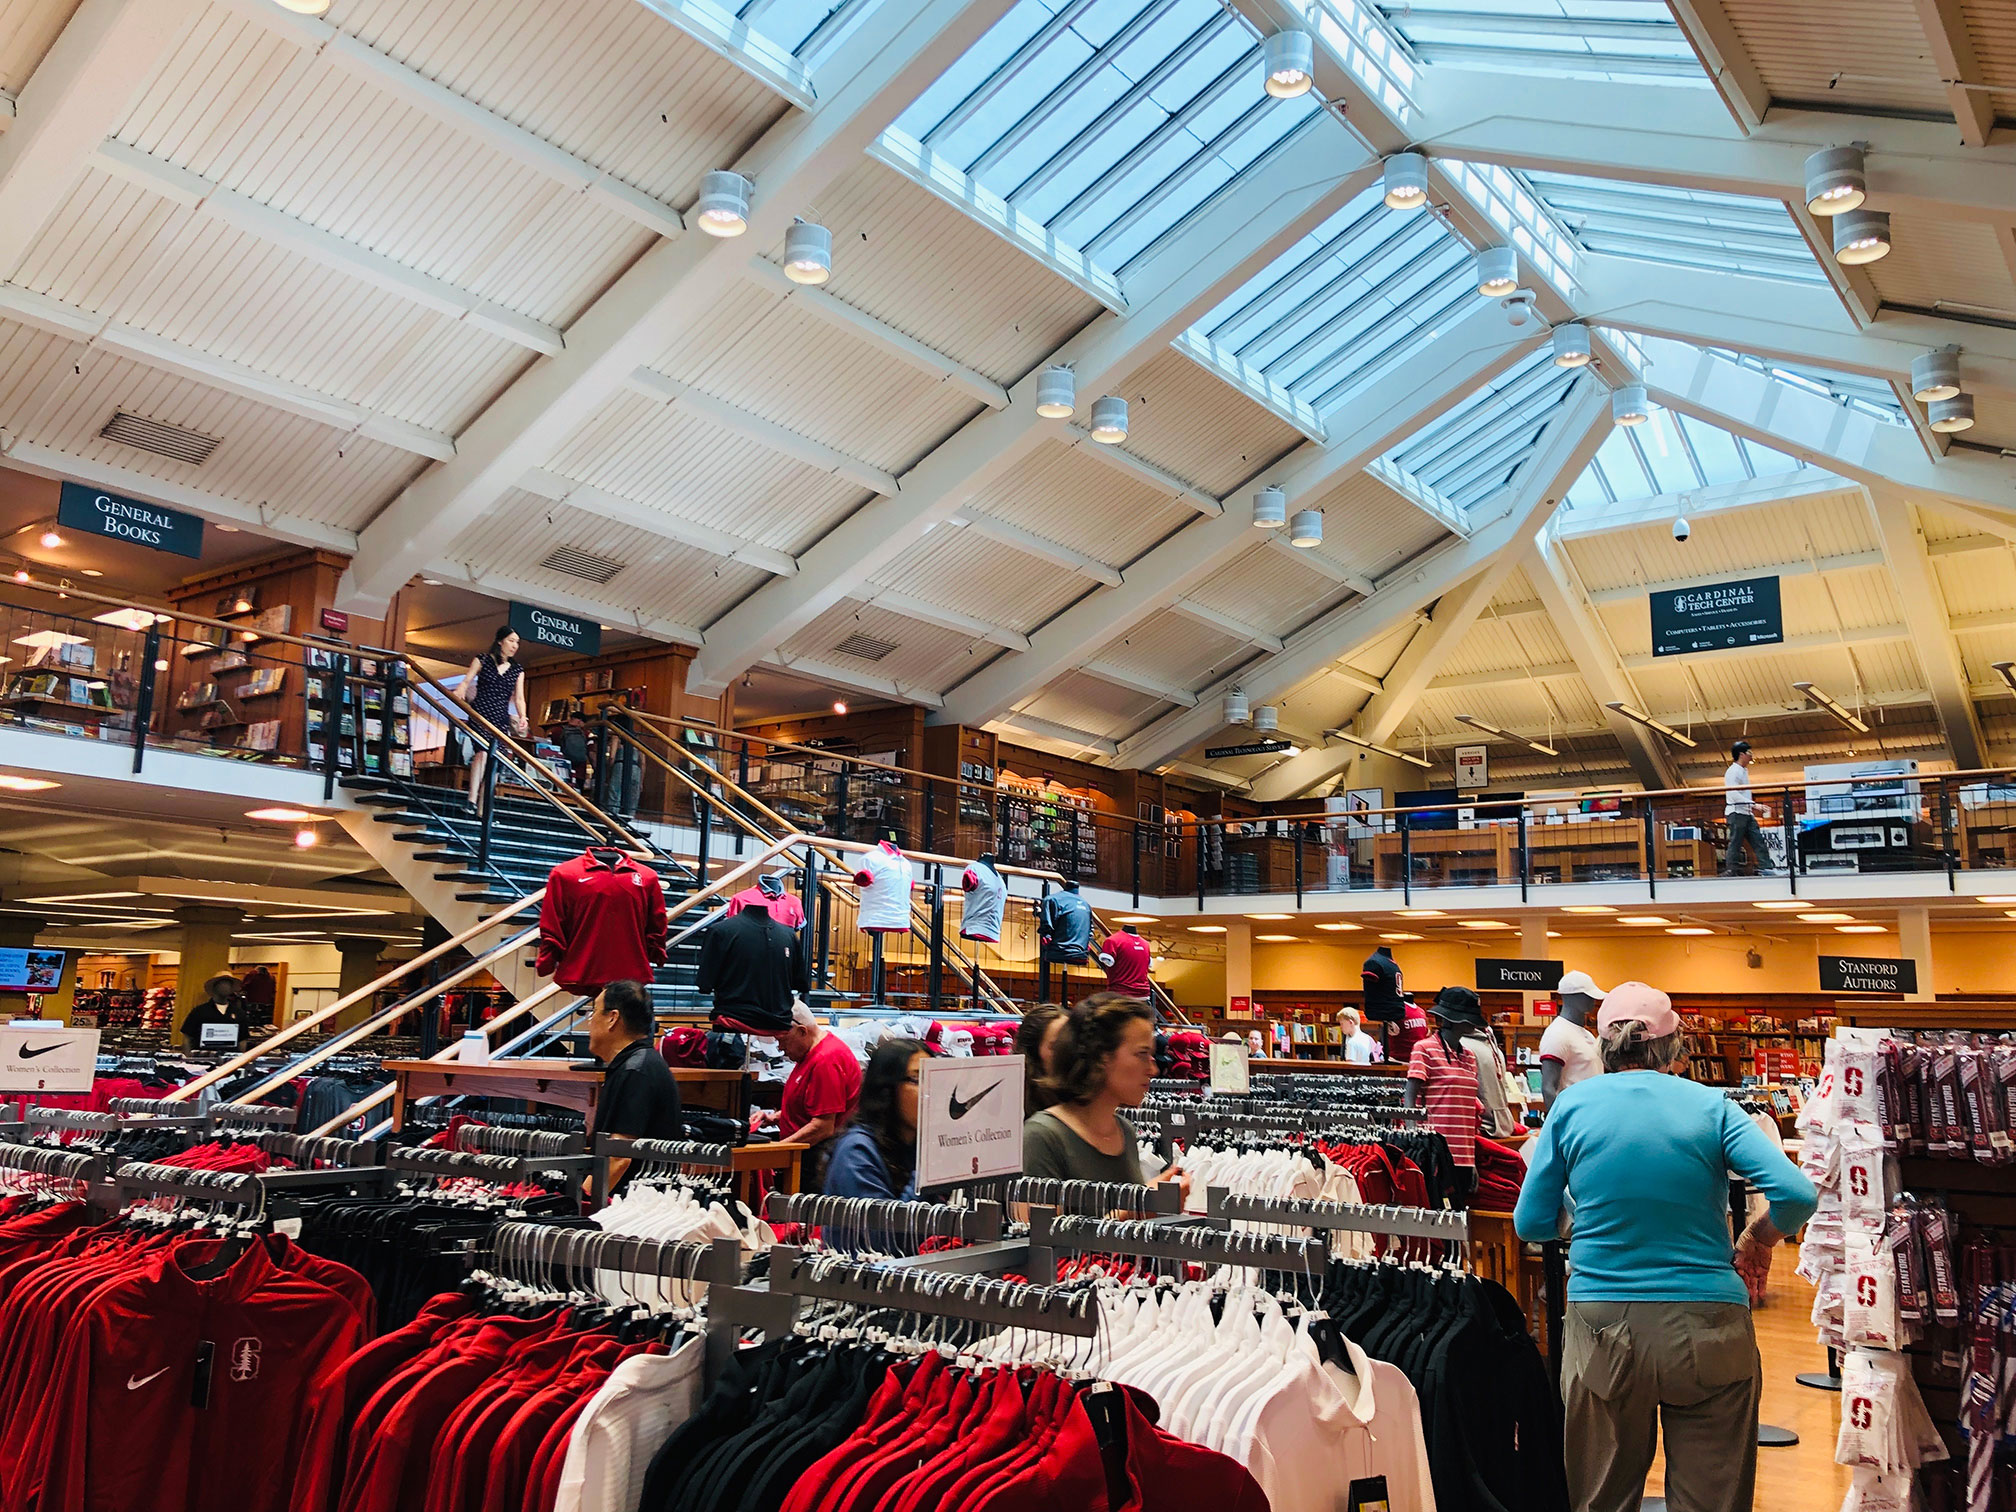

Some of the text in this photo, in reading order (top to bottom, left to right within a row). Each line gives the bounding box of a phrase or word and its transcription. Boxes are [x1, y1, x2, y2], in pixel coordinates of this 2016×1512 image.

[94, 495, 174, 530] GENERAL
[103, 516, 161, 545] BOOKS
[1687, 586, 1754, 602] CARDINAL
[1687, 595, 1754, 612] TECH CENTER
[530, 610, 582, 635] GENERAL
[1665, 627, 1698, 637] COMPUTERS
[536, 626, 575, 648] BOOKS
[1499, 967, 1542, 982] FICTION
[1838, 959, 1898, 976] STANFORD
[1842, 976, 1897, 990] AUTHORS
[6, 1064, 81, 1075] Women's Collection
[1942, 1084, 1957, 1126] STANFORD
[1967, 1092, 1982, 1134] STANFORD
[937, 1127, 1012, 1148] Women's Collection
[1897, 1252, 1912, 1295] STANFORD
[1932, 1250, 1949, 1293] STANFORD
